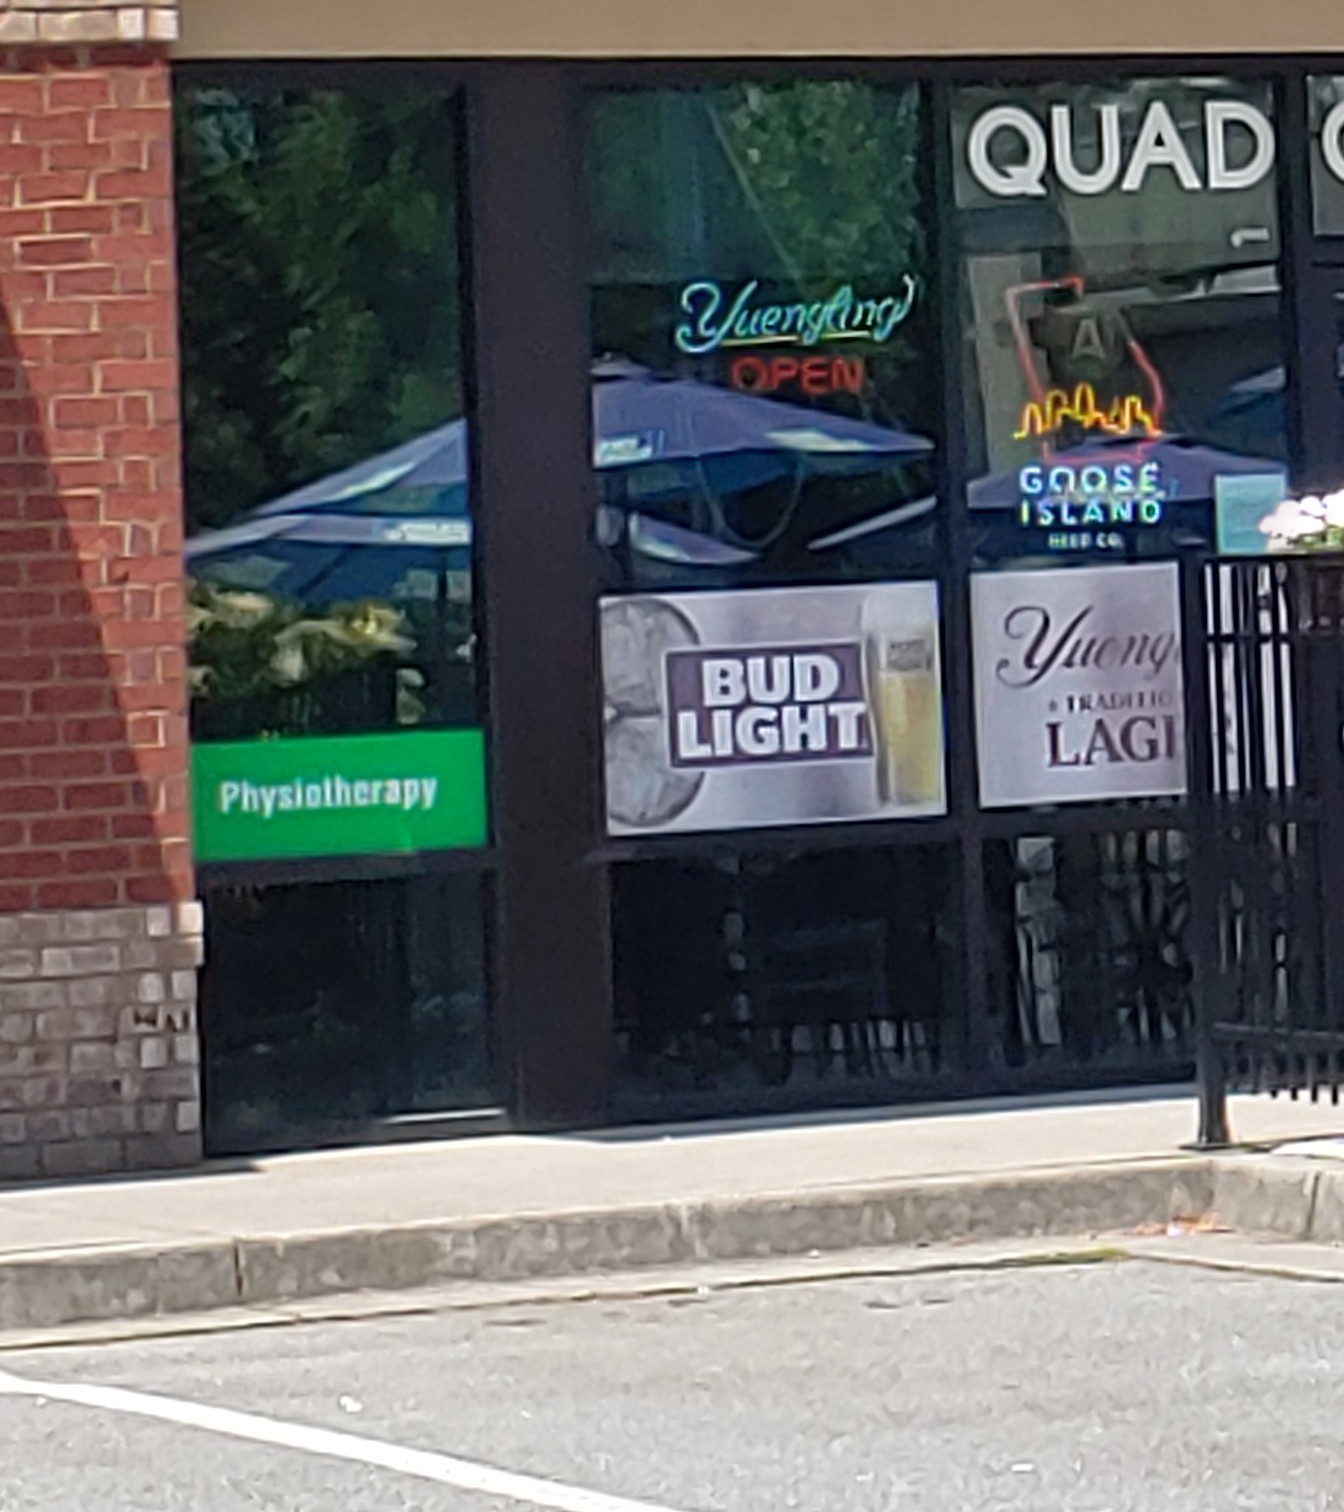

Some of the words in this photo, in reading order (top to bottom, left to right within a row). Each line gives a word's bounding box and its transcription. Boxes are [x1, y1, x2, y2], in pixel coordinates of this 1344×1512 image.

[968, 100, 1275, 197] QUAD
[675, 274, 916, 354] Yuengling
[730, 354, 866, 394] OPEN
[1019, 462, 1161, 494] GOOSE
[1020, 497, 1161, 527] ISLAND
[702, 653, 840, 707] BUD
[677, 702, 868, 760] LIGHT
[219, 773, 438, 820] Physiotherapy
